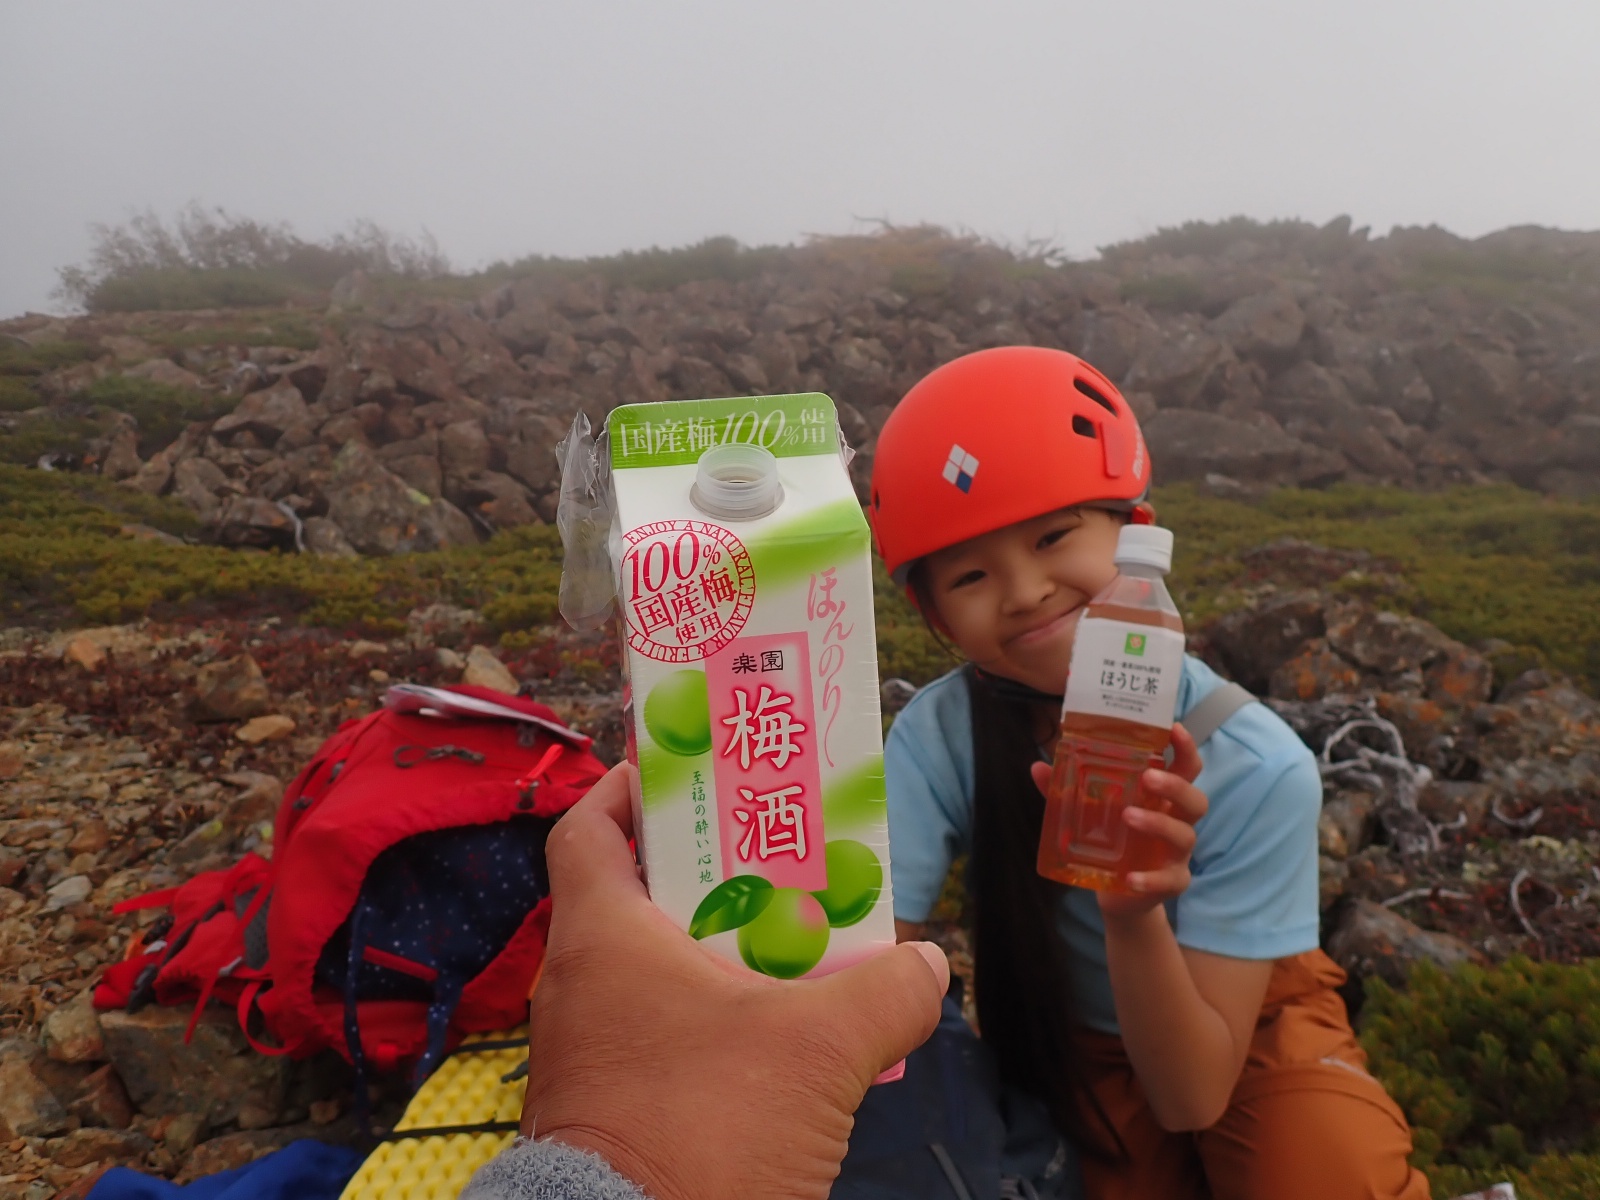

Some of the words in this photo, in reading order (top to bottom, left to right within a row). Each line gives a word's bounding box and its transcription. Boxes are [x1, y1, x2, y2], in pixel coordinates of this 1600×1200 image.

[622, 520, 677, 546] ENJOY
[683, 520, 694, 532] A
[627, 531, 722, 603] 100%
[632, 566, 738, 638] 国産梅
[675, 611, 723, 646] 使用
[714, 593, 755, 651] FLAVOR
[626, 630, 691, 662] FRUITY
[697, 643, 709, 658] &
[731, 650, 785, 675] 楽園
[806, 566, 856, 768] ほんのり
[1101, 670, 1159, 694] ほうじ茶
[722, 685, 807, 861] 梅酒
[691, 770, 714, 884] 至福の酔い心地
